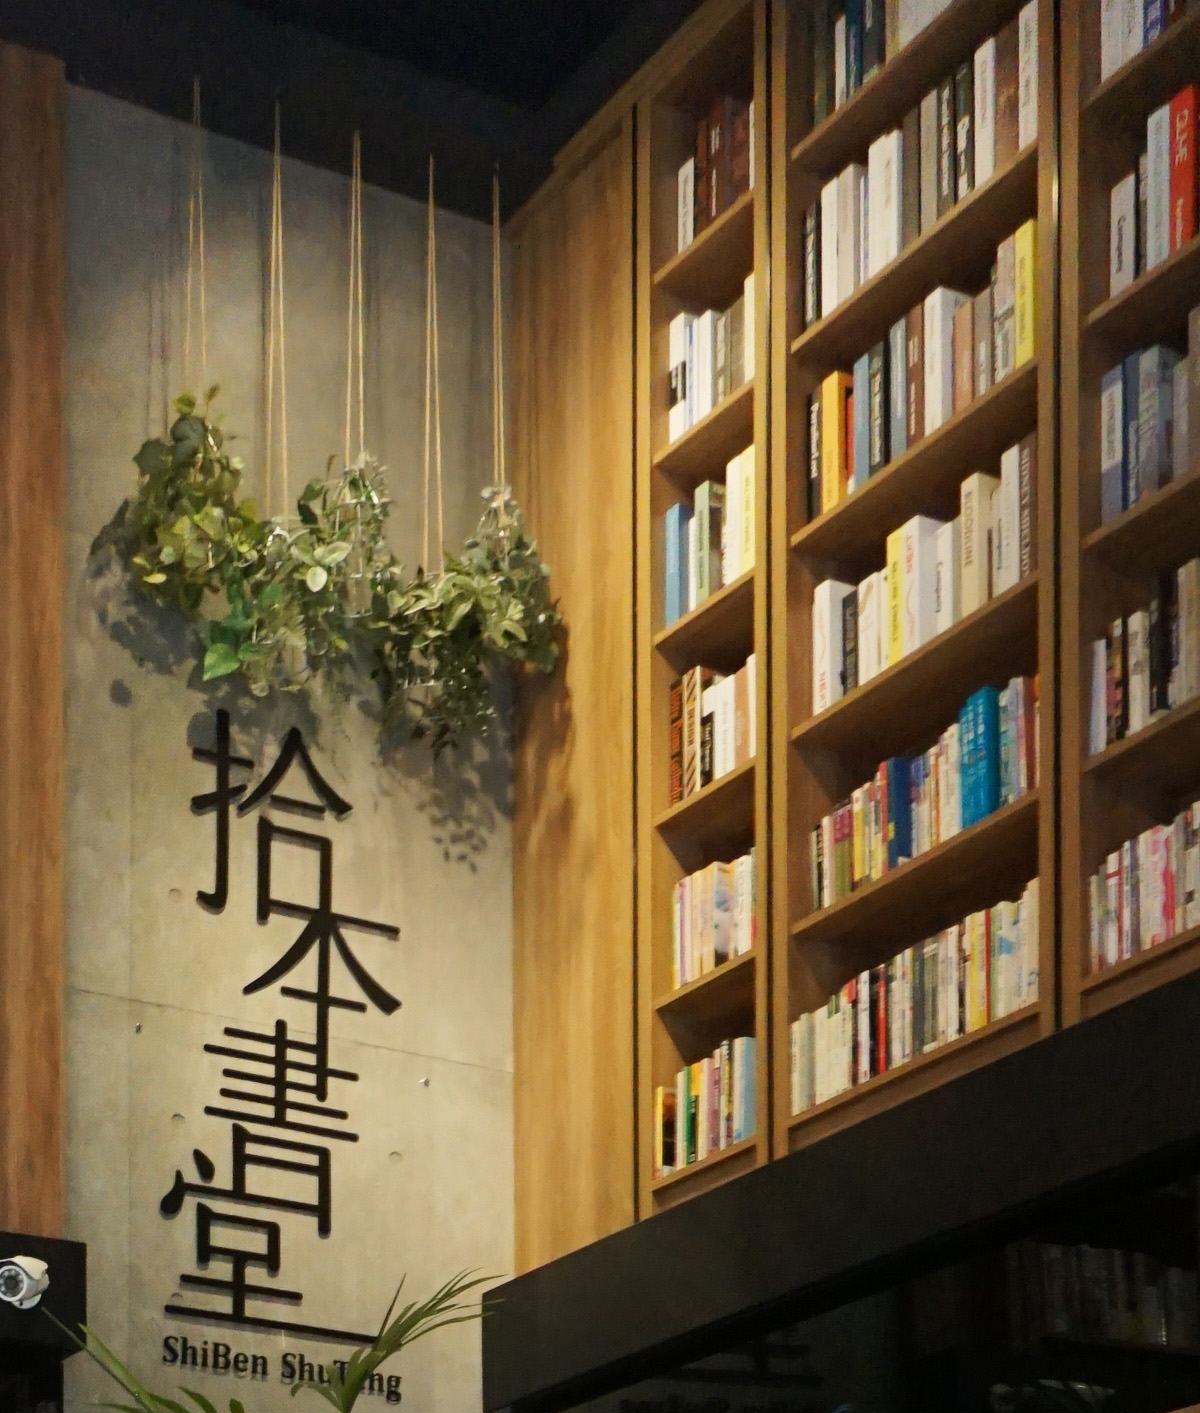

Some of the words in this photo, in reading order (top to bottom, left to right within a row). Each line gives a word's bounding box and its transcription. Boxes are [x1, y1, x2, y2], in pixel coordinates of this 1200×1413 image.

[160, 708, 402, 1343] 拾本書堂
[162, 1335, 268, 1377] ShiBen
[281, 1351, 403, 1405] ShuTng
